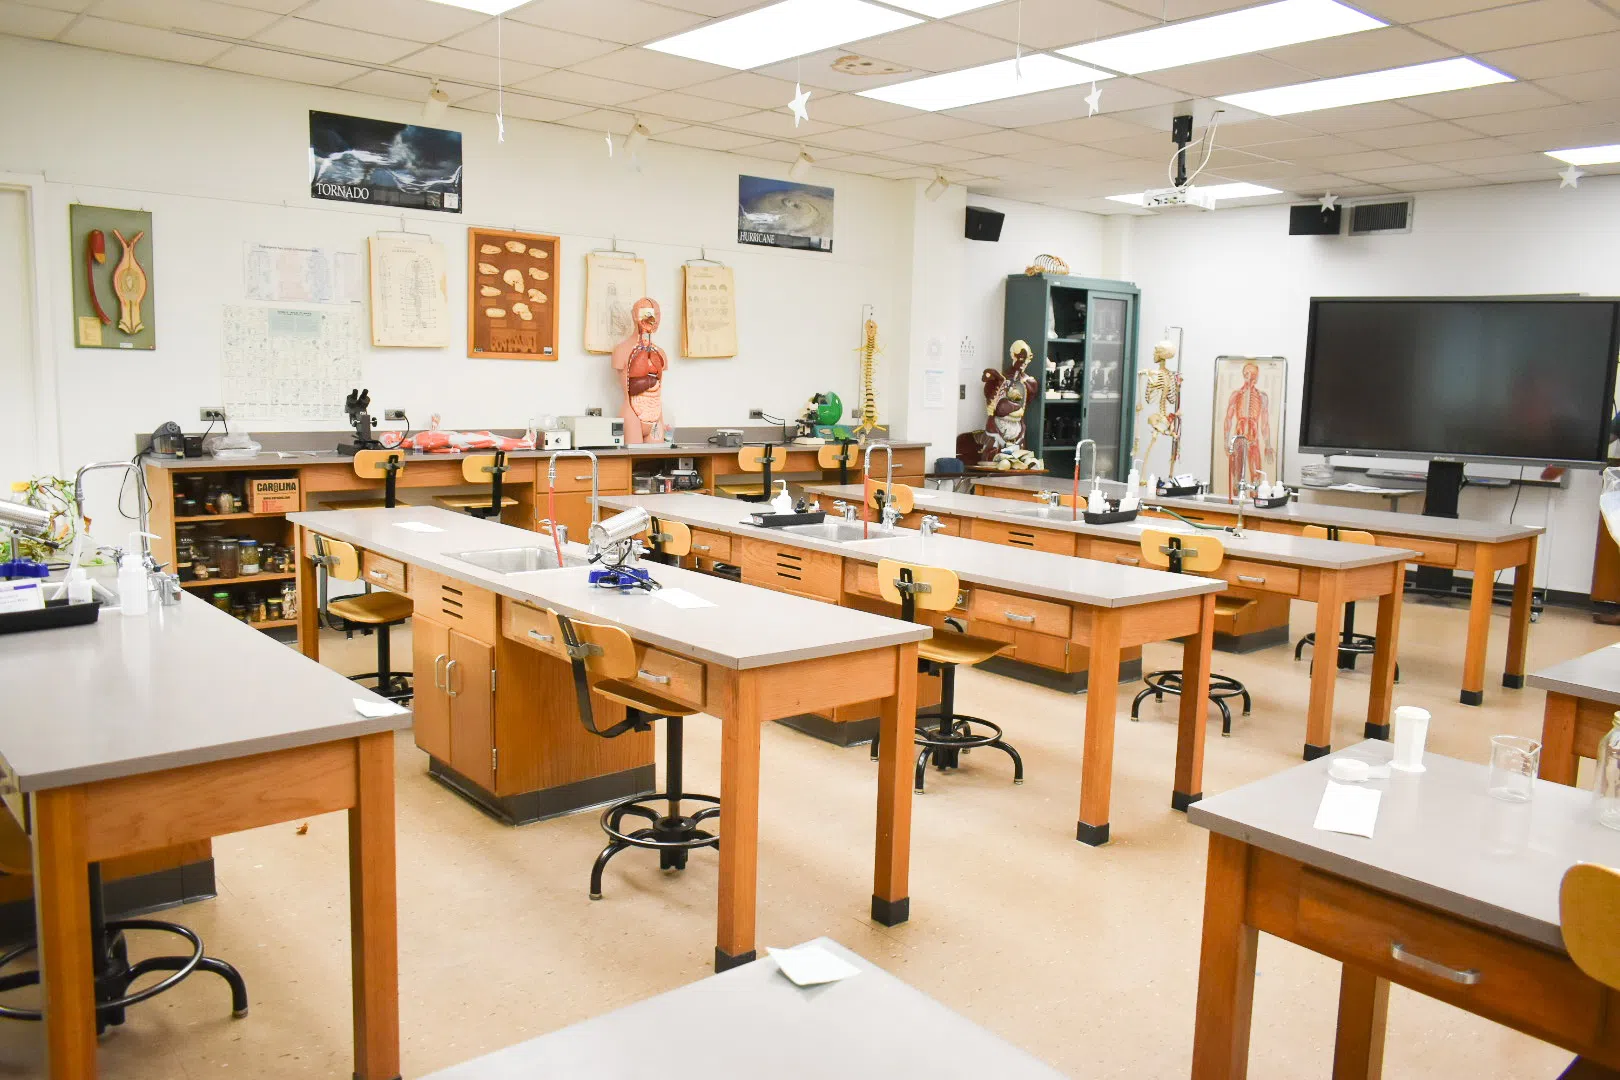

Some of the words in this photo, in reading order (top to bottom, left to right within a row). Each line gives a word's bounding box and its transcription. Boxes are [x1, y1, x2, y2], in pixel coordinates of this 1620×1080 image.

[316, 183, 370, 200] TORNADO
[740, 231, 775, 244] HURRICANE
[257, 482, 296, 492] CAROLINA
